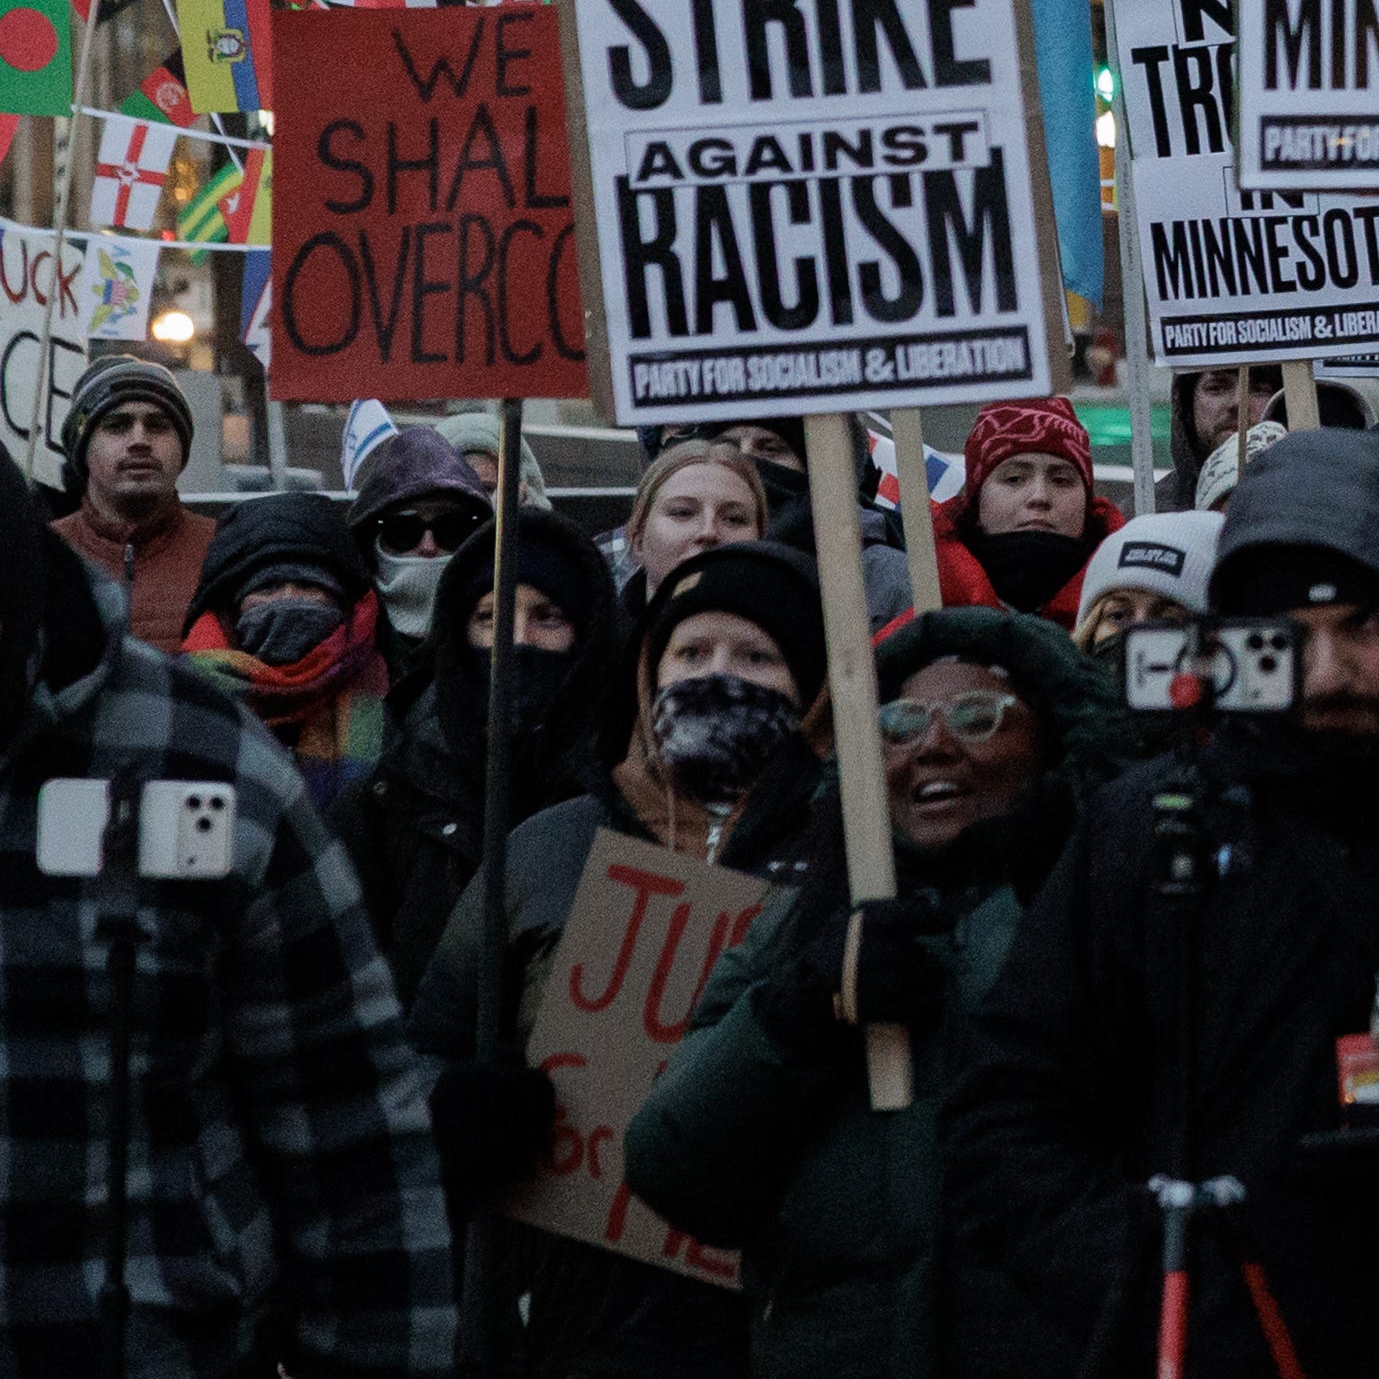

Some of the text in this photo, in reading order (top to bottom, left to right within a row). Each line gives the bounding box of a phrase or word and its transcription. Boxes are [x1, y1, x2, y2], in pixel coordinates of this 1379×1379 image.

[392, 11, 534, 103] WE
[635, 121, 981, 182] AGAINST
[616, 147, 1020, 341] RACISM
[1165, 321, 1208, 349] PARTY
[1209, 320, 1237, 345] FOR
[1238, 316, 1312, 344] SOCIALISM
[1314, 314, 1333, 339] &
[748, 349, 862, 391] SOCIALISM
[865, 348, 896, 382] &
[898, 337, 1026, 378] LIBERATION
